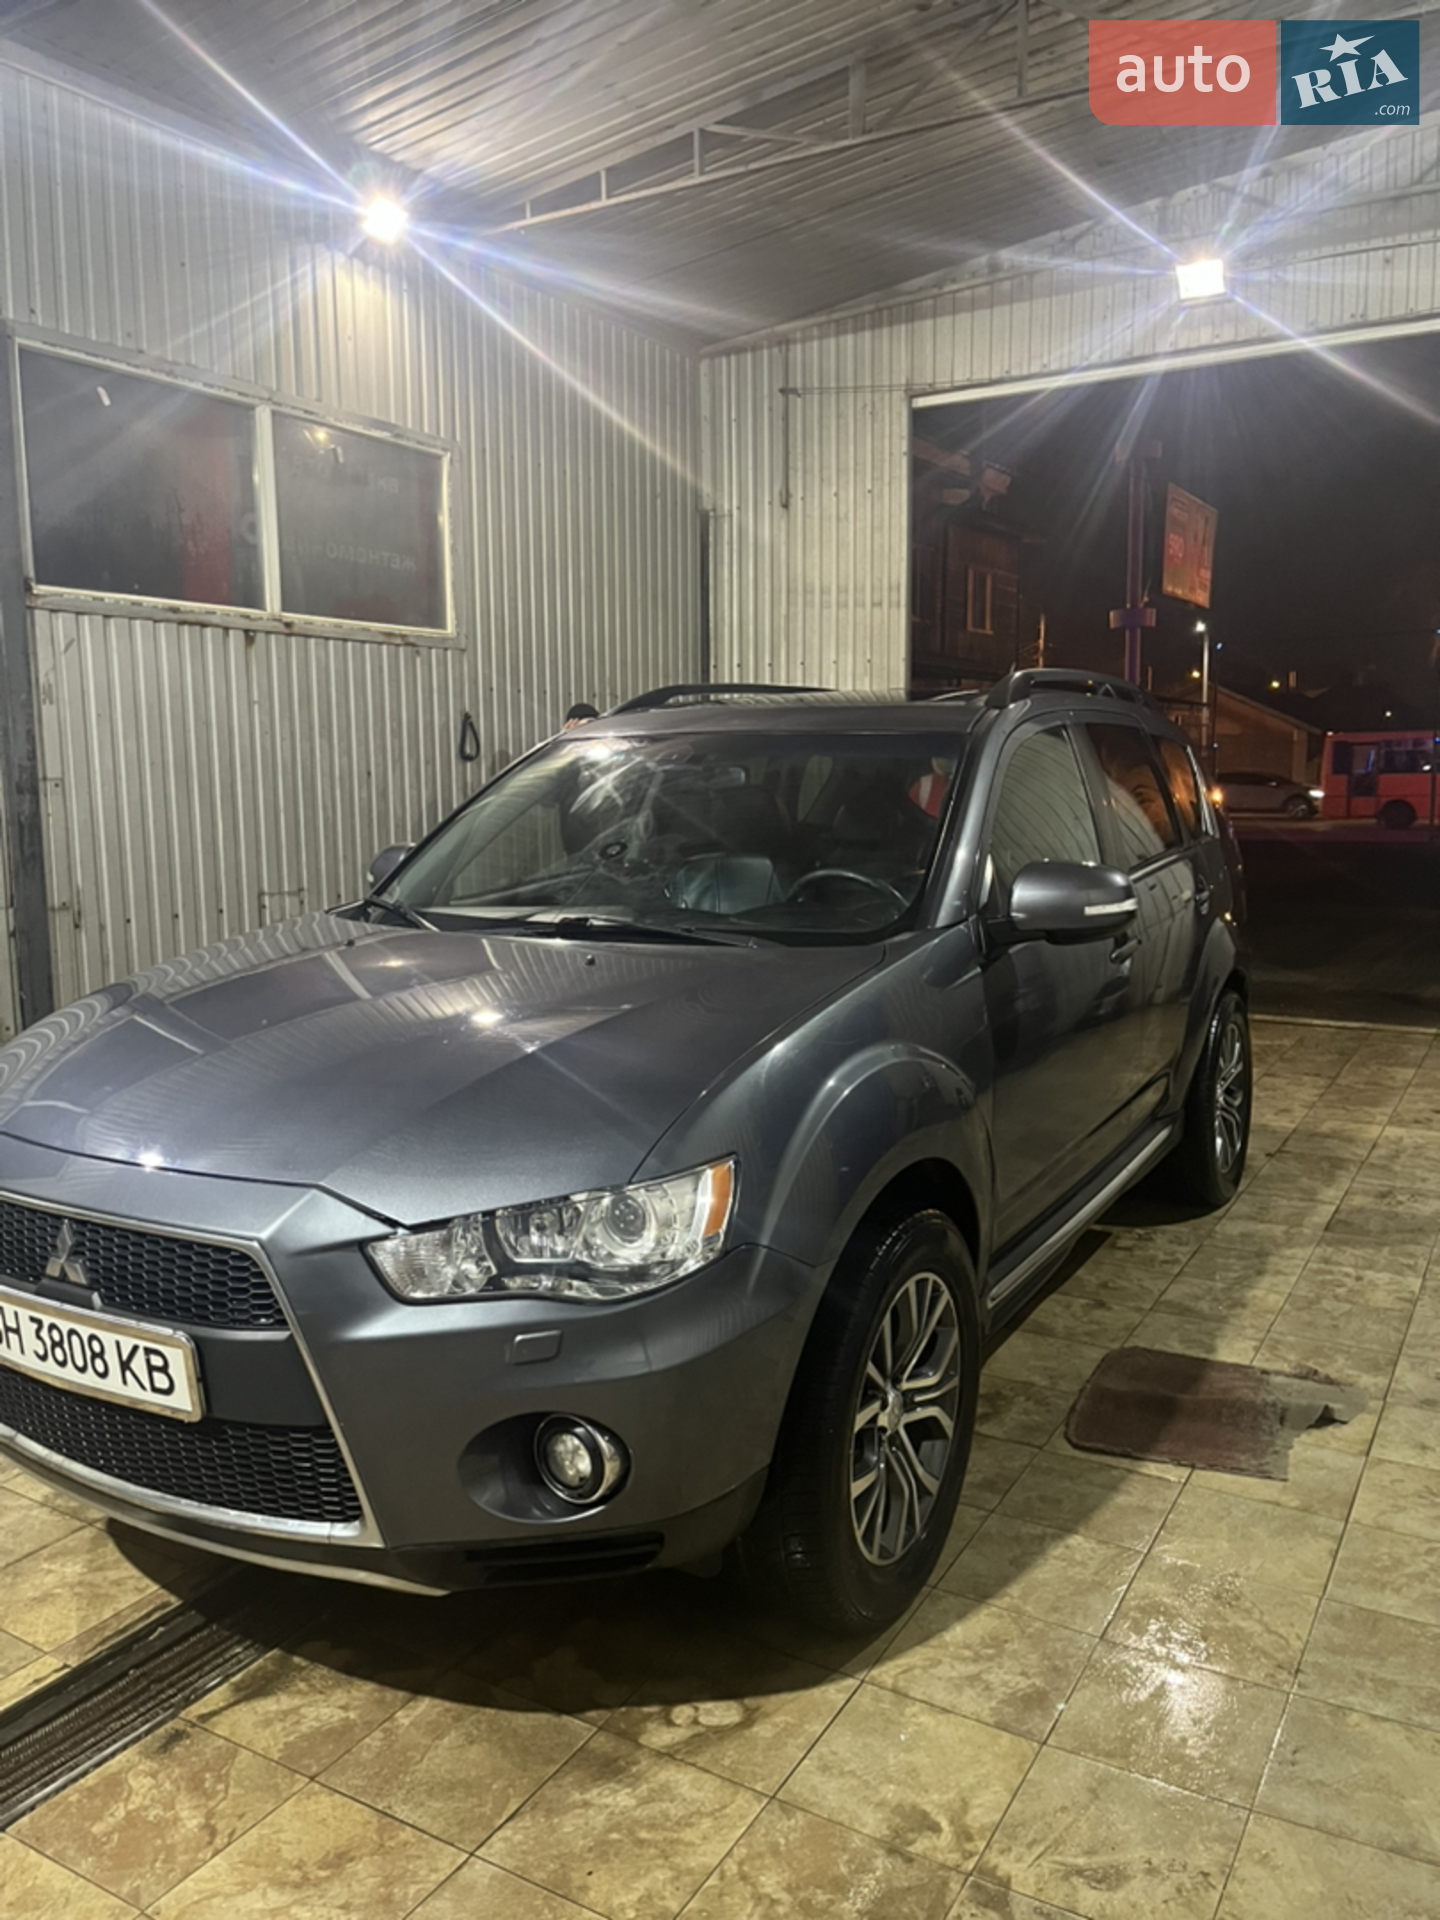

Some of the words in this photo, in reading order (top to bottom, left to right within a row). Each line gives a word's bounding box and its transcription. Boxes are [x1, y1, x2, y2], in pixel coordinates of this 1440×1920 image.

[0, 1306, 25, 1356] H
[29, 1315, 110, 1379] 3808
[115, 1339, 175, 1396] KB
